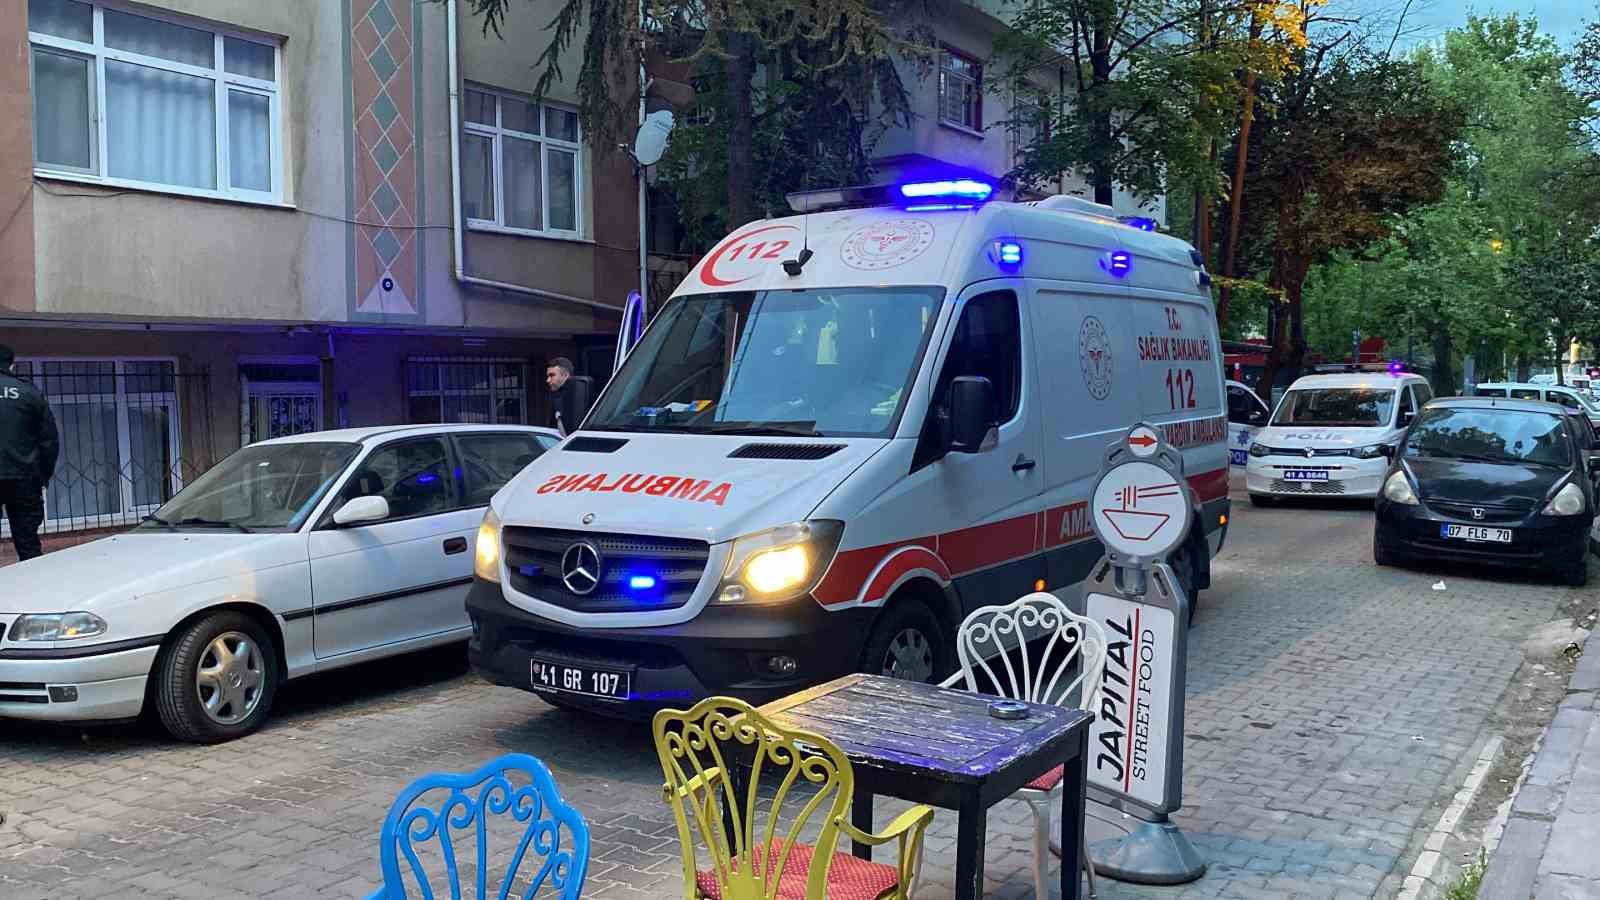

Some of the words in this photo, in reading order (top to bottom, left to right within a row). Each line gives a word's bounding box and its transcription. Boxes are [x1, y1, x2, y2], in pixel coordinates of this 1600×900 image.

[728, 240, 790, 262] 112
[1138, 332, 1171, 361] SAĞLIK
[1166, 368, 1196, 410] 112
[1298, 471, 1304, 479] A
[1449, 525, 1461, 536] 07
[1468, 527, 1487, 539] FLG
[1496, 529, 1510, 541] 70
[1139, 629, 1155, 694] FOOD
[540, 664, 556, 686] 41
[563, 668, 582, 691] GR
[592, 671, 620, 695] 107
[1097, 614, 1133, 783] JAPITAL
[1133, 698, 1150, 781] STREET
